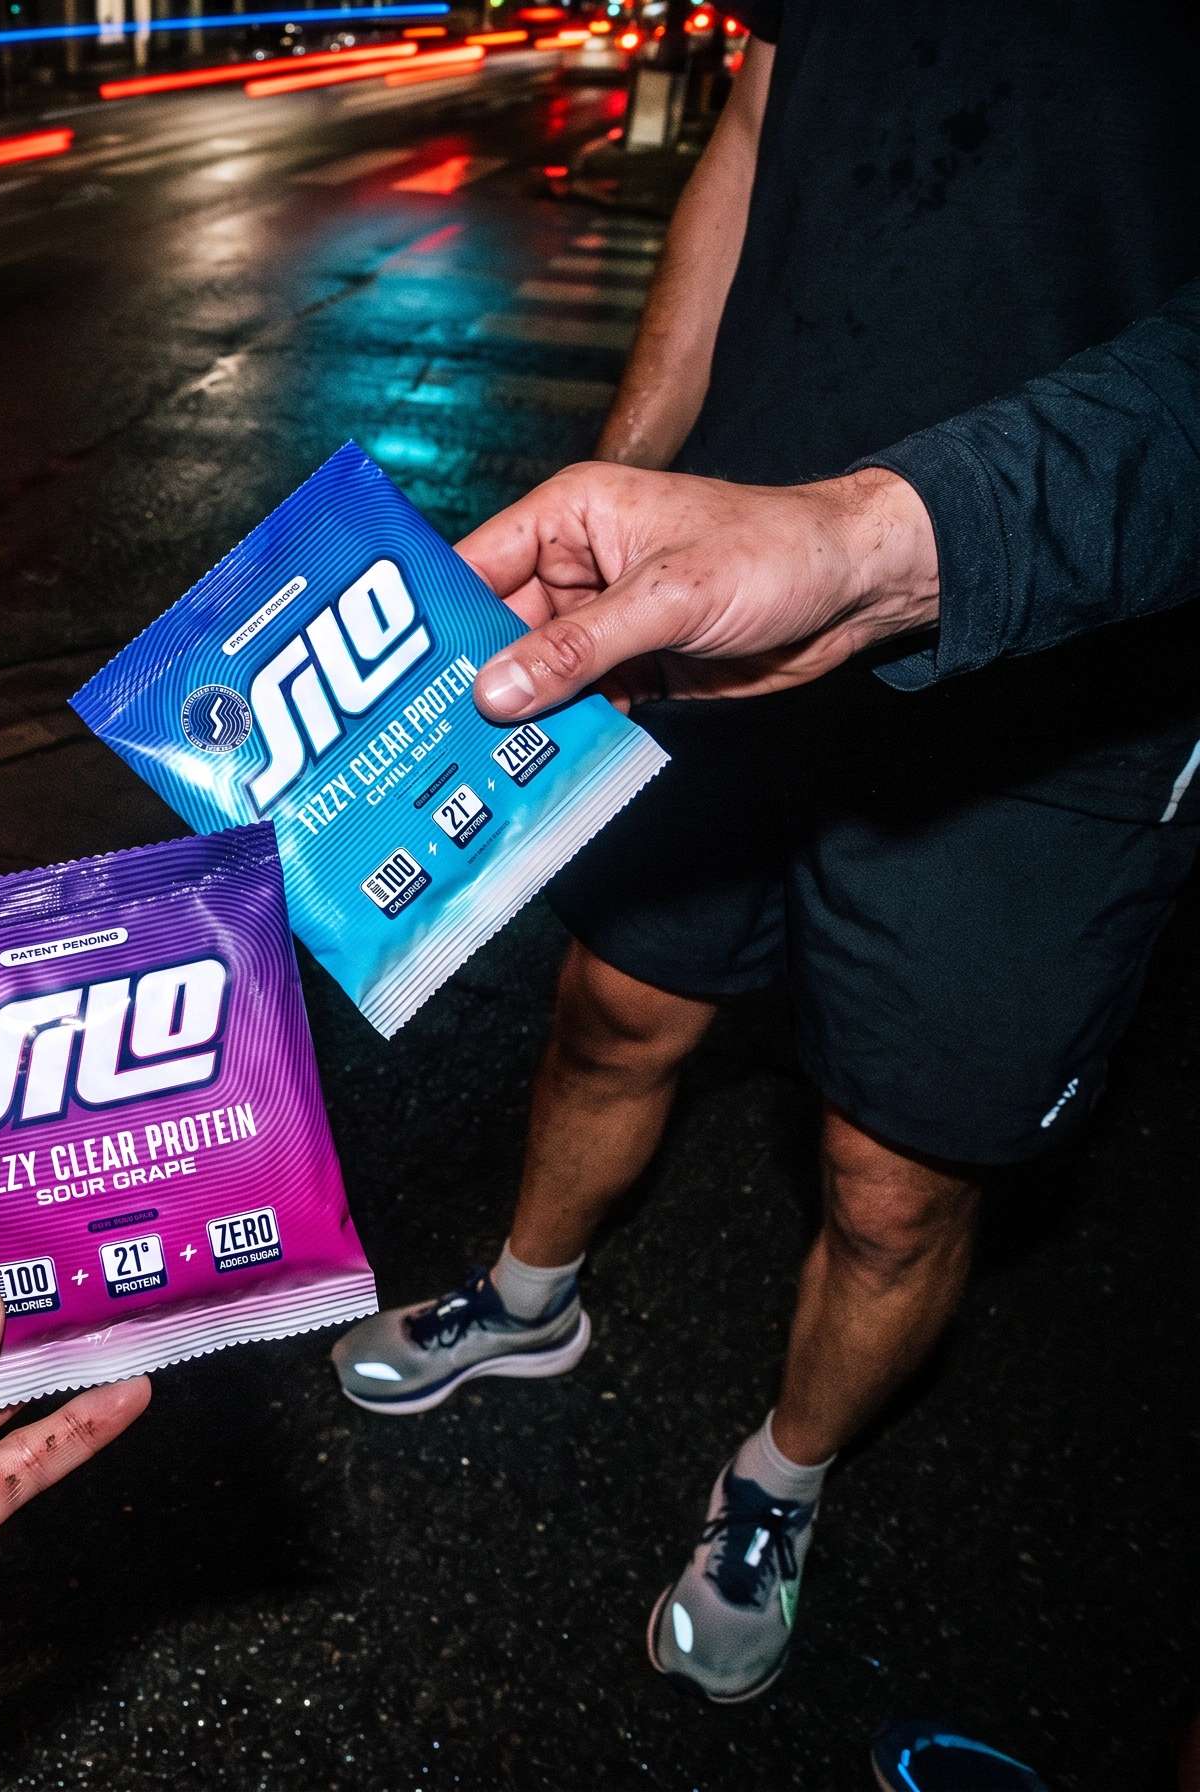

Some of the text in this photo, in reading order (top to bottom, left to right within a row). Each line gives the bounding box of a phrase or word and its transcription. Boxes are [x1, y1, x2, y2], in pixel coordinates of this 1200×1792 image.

[297, 773, 356, 836] FIZZY
[349, 720, 414, 786] CLEAR
[403, 654, 479, 734] PROTEIN
[411, 718, 452, 762] BLUE
[496, 725, 544, 772] ZERO
[375, 853, 416, 894] 100
[10, 932, 119, 961] PATENT PENDING
[50, 1130, 139, 1182] CLEAR
[144, 1102, 257, 1161] PROTEIN
[35, 1156, 197, 1206] SOUR GRAPE
[214, 1213, 275, 1254] ZERO
[249, 1247, 280, 1262] SUGAR
[4, 1263, 49, 1297] 100
[115, 1275, 161, 1294] PROTEIN
